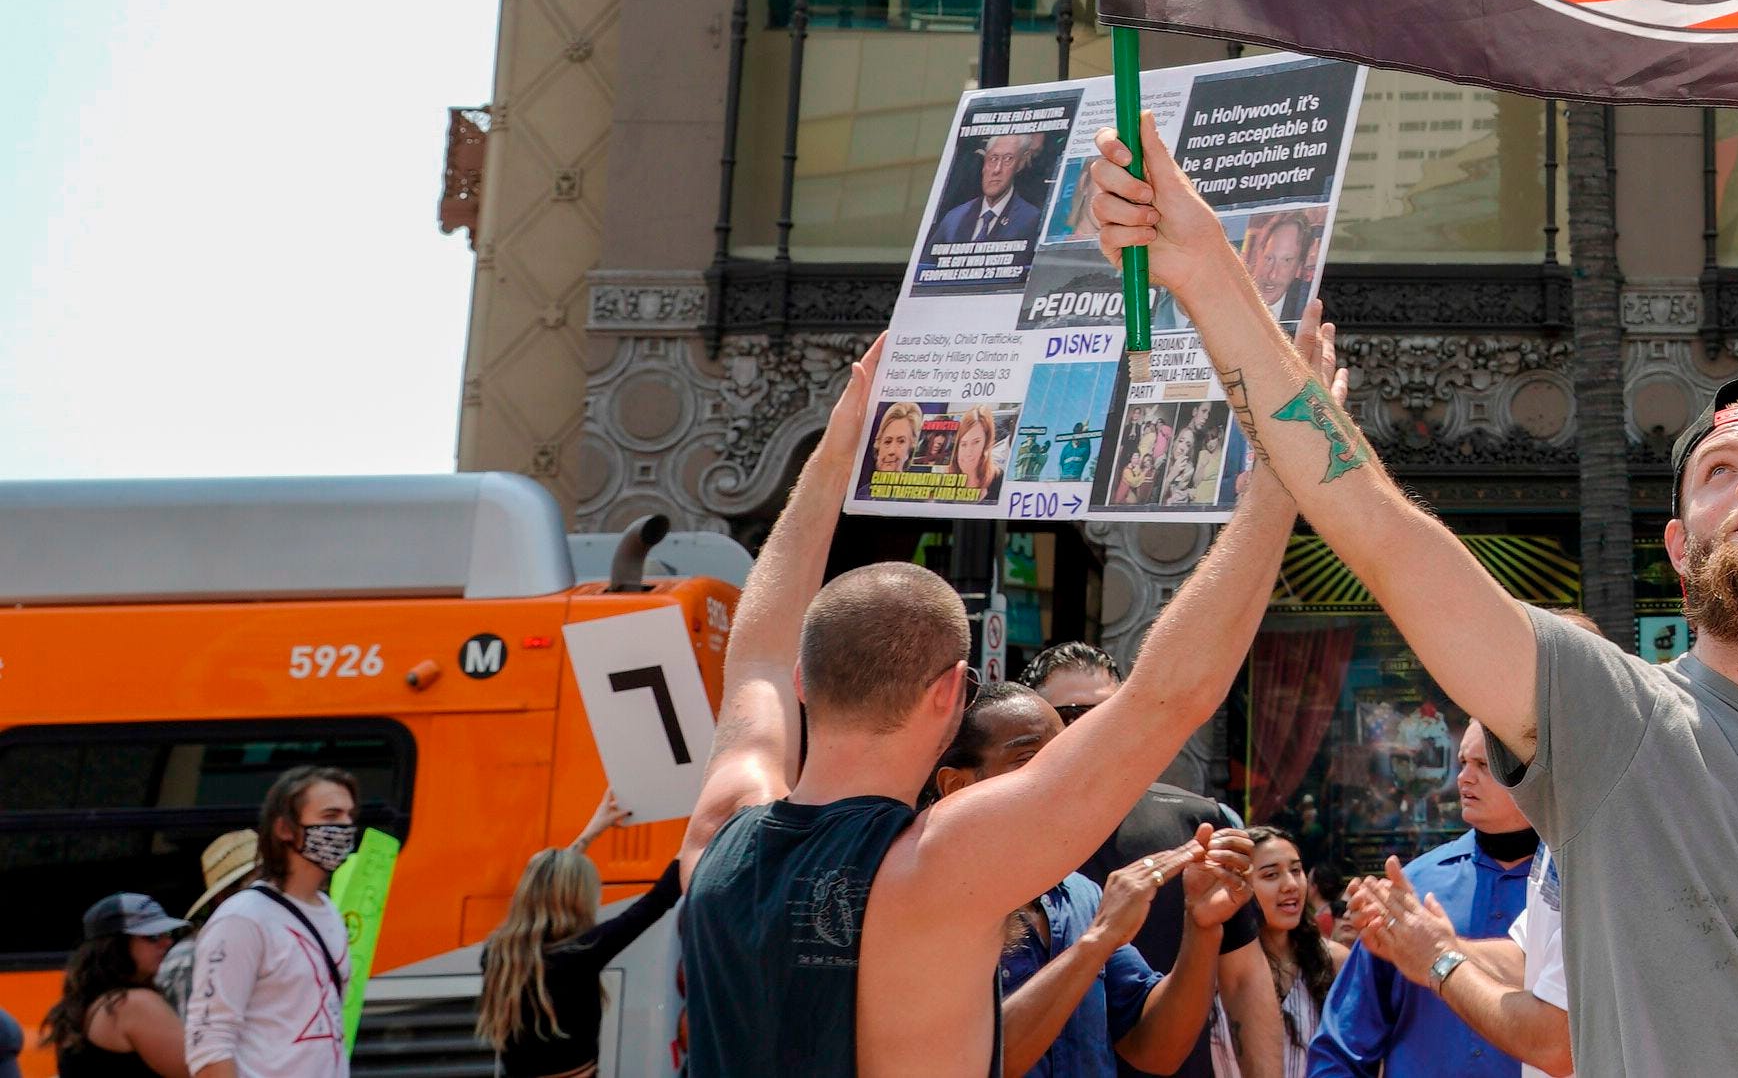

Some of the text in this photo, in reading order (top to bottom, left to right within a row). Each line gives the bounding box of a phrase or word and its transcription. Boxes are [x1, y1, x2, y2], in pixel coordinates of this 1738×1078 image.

[1193, 94, 1320, 126] In Hollywood, it's
[1187, 117, 1328, 149] more acceptable to
[1182, 141, 1328, 173] be a pedophile than
[1192, 166, 1316, 194] Trump supporter
[937, 257, 952, 268] THE
[1028, 288, 1157, 321] PEDOWO
[895, 334, 921, 346] Laura
[954, 333, 978, 345] Child
[1045, 333, 1113, 358] DISNEY
[890, 351, 1019, 364] Rescued by Hillary Clinton in
[1185, 352, 1197, 365] AT
[885, 368, 1011, 382] Haiti After Trying to Steal 33
[880, 386, 951, 398] Haitian Children
[961, 382, 996, 399] 2010
[1129, 385, 1156, 399] PARTY
[1009, 492, 1058, 518] PEDO
[289, 644, 385, 679] 5926
[465, 639, 503, 674] M
